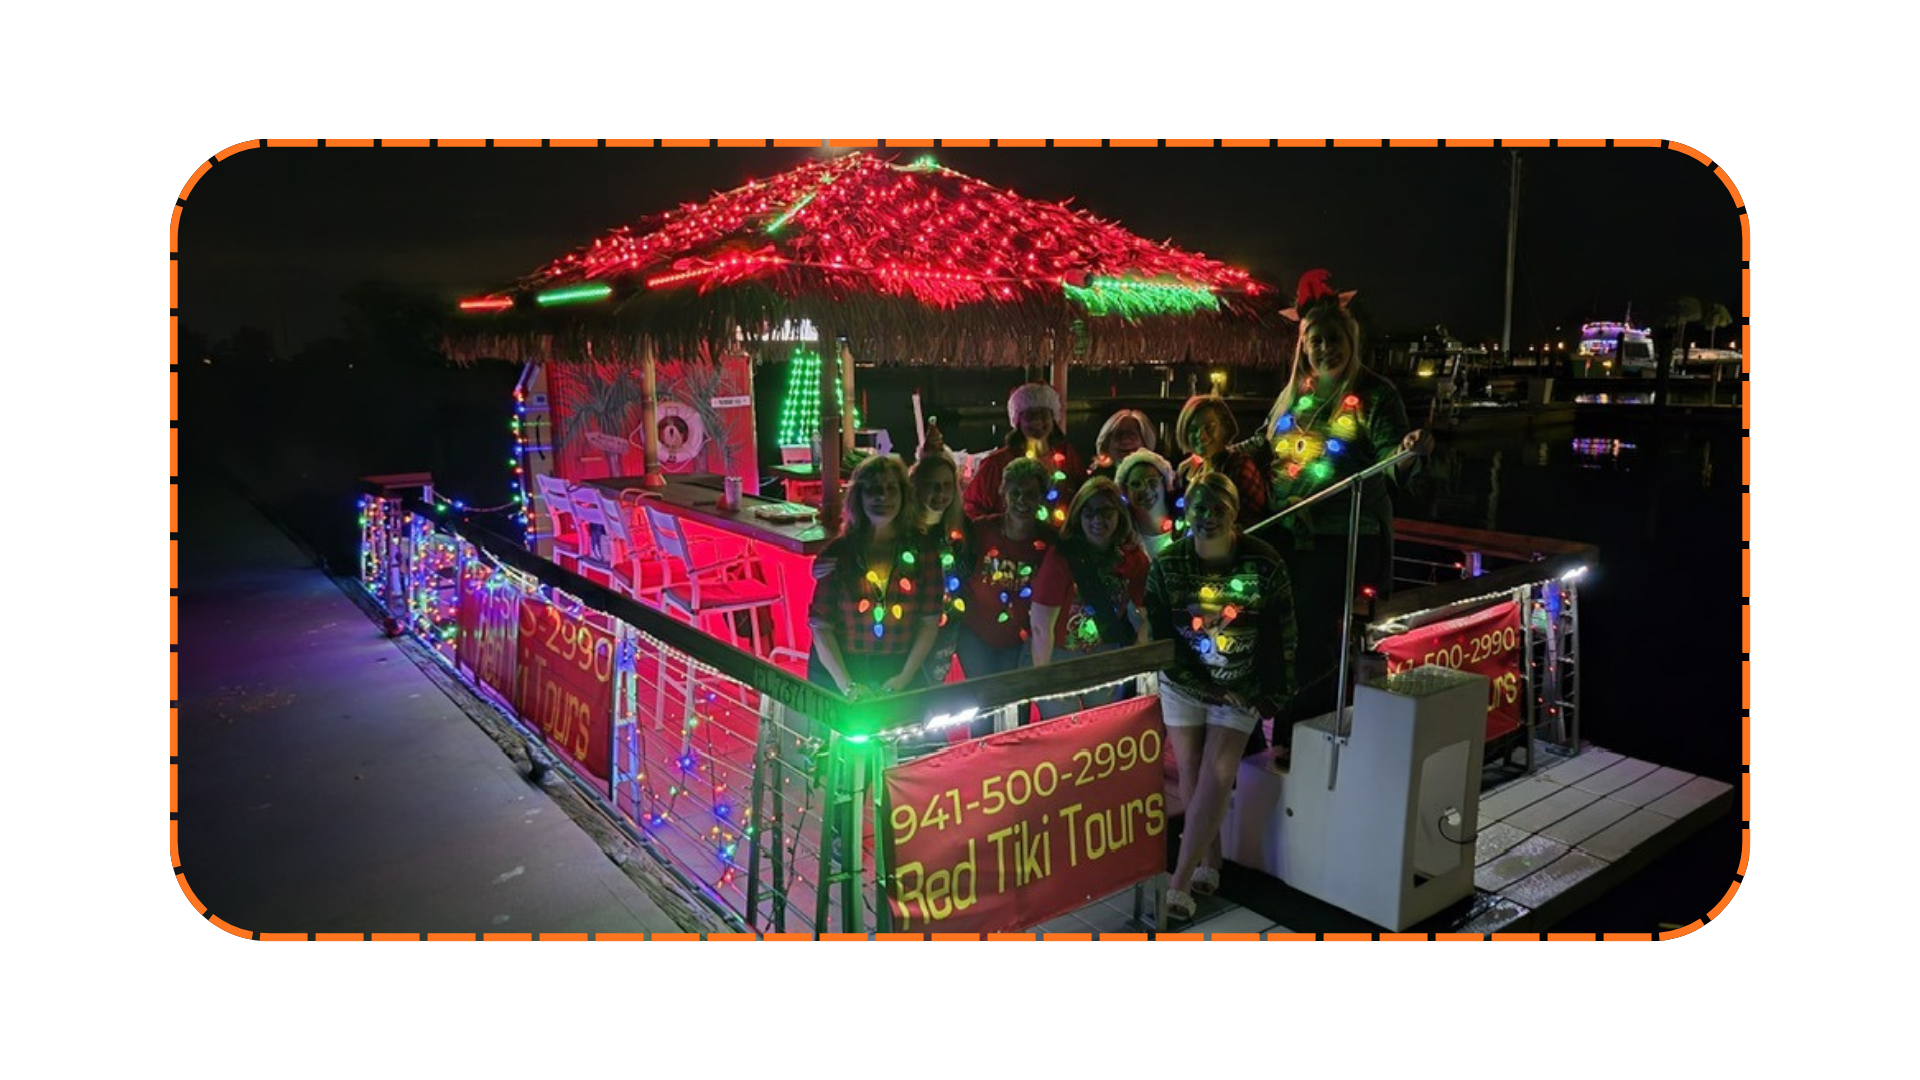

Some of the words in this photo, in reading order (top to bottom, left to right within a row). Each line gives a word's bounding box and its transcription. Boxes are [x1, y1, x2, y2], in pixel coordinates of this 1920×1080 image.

[534, 653, 591, 761] Tours
[1486, 671, 1518, 712] urs
[890, 728, 1162, 845] 941-500-2990
[895, 837, 978, 932] Red
[987, 813, 1052, 894] Tiki
[1060, 792, 1165, 867] Tours
